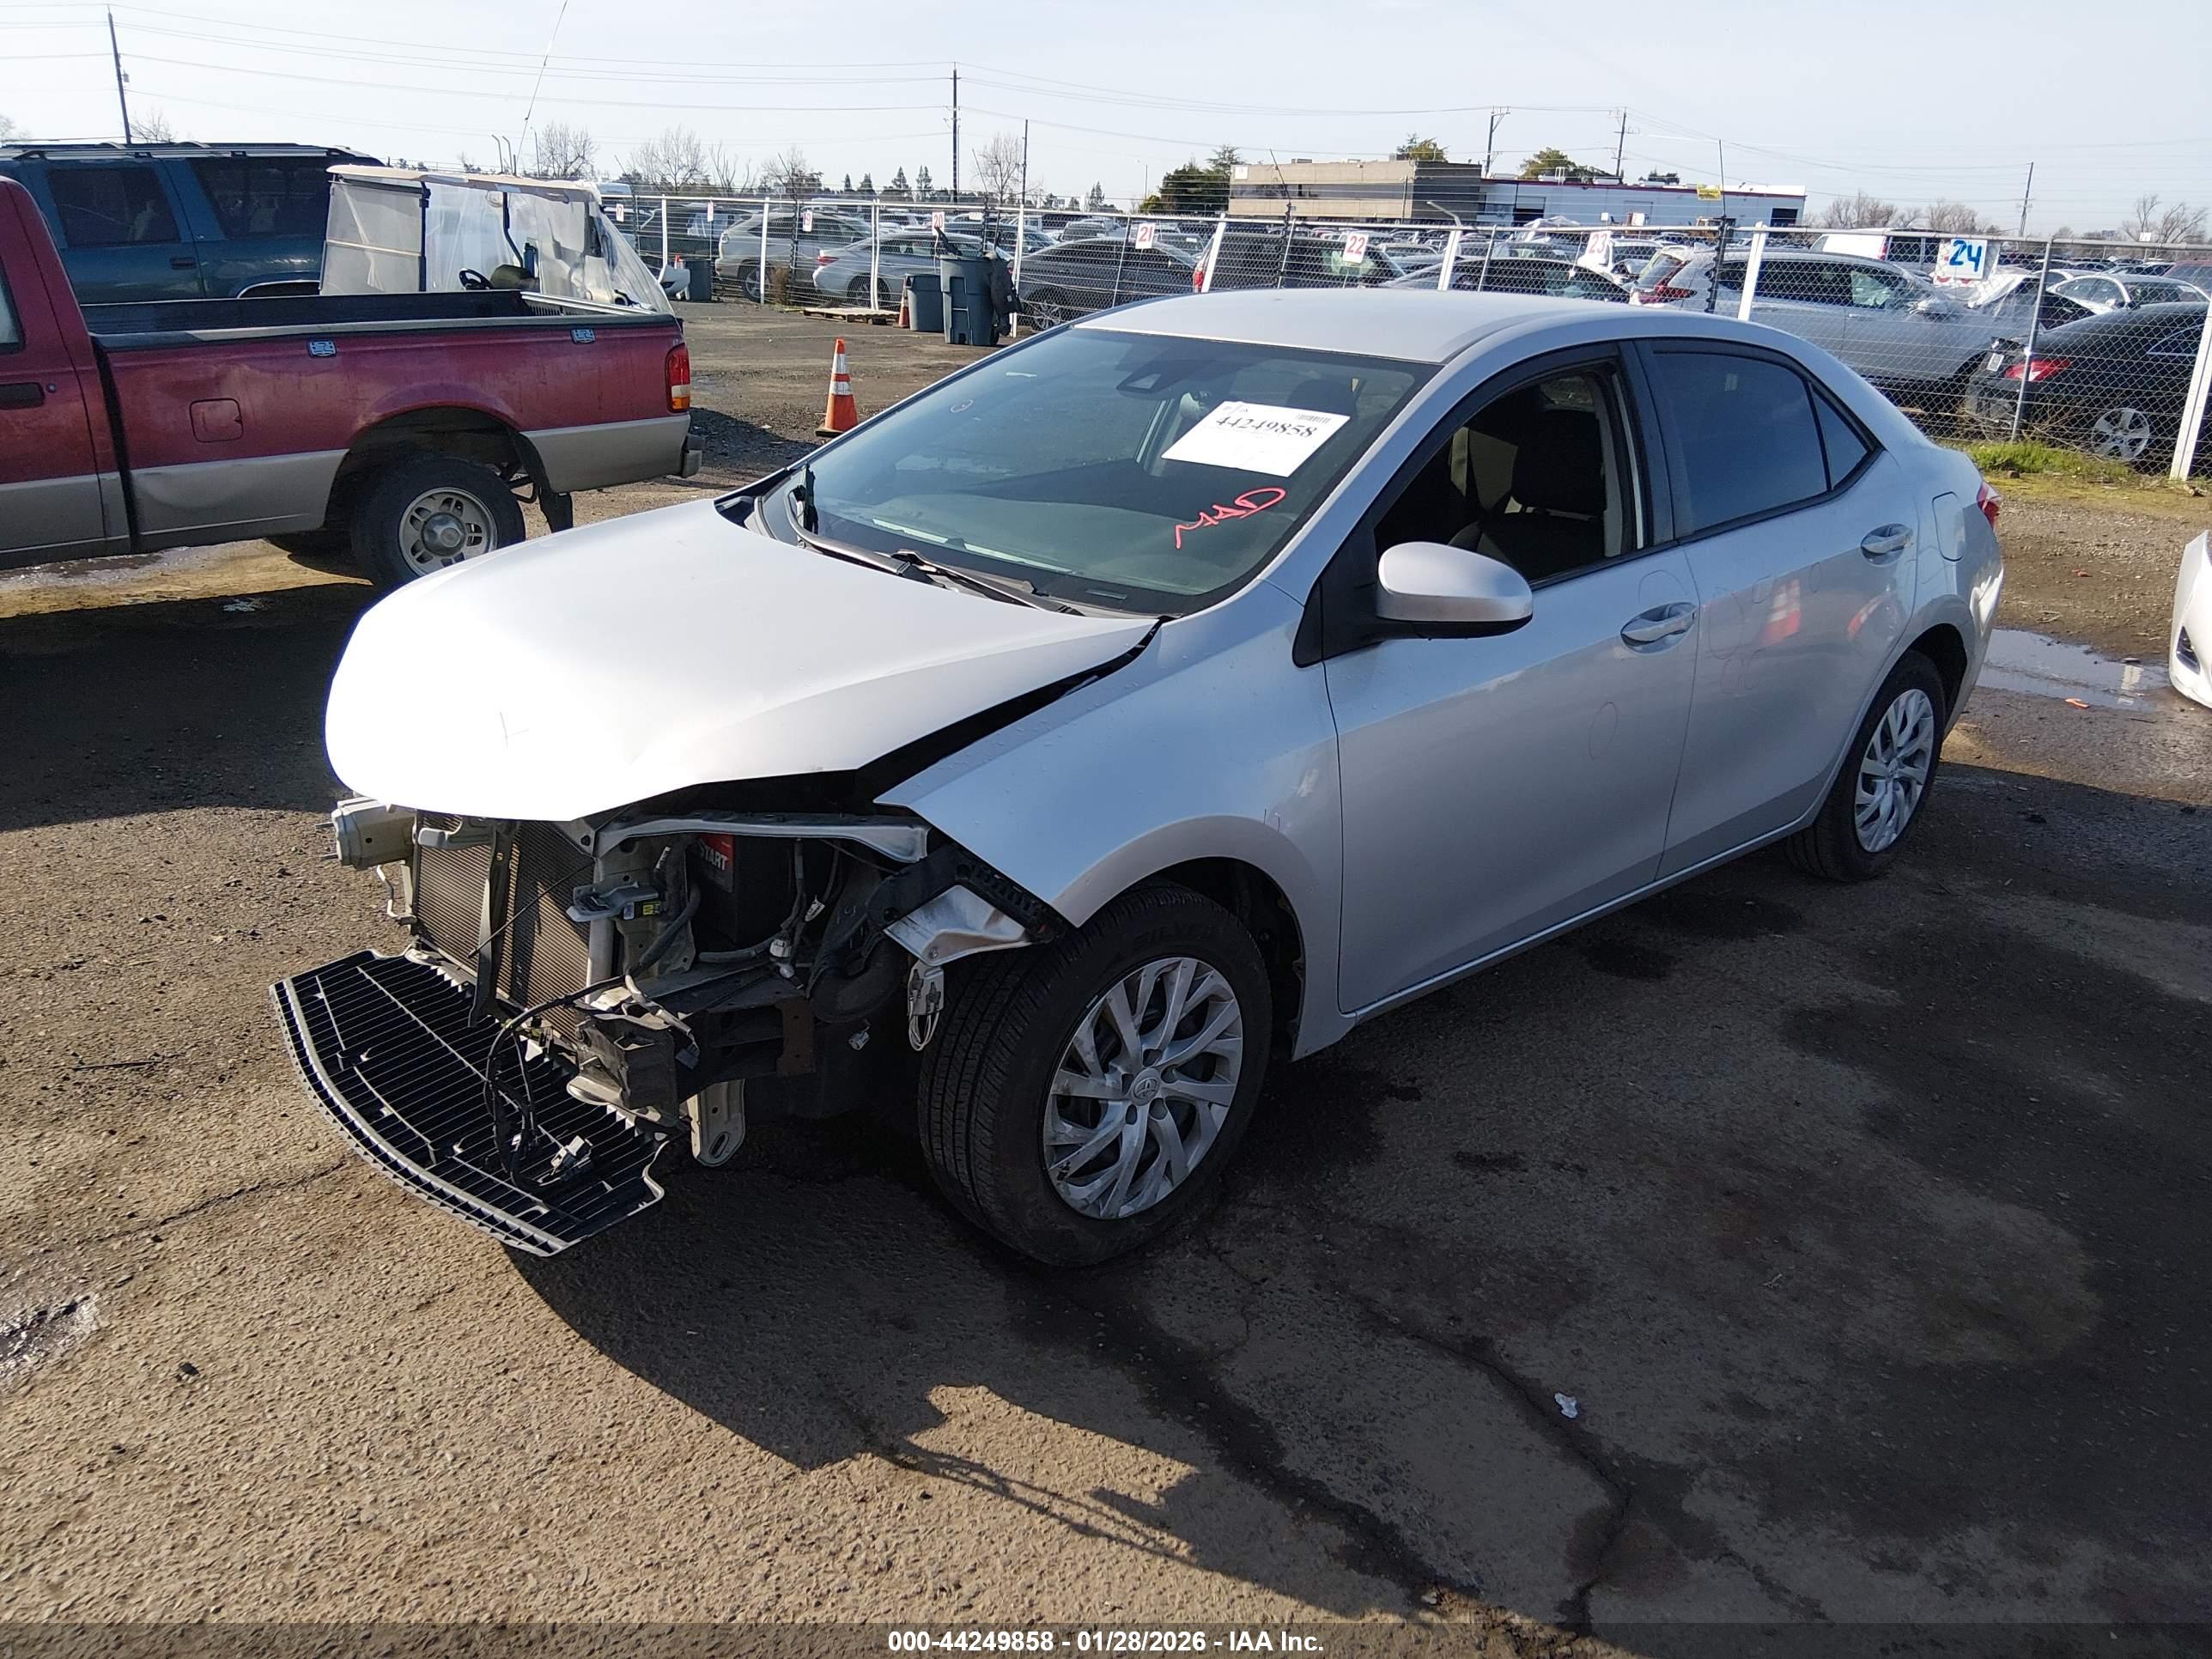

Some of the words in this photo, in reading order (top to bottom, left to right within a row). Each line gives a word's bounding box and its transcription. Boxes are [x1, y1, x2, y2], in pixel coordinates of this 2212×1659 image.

[933, 213, 944, 228] 20
[1138, 226, 1153, 242] 21
[1588, 233, 1608, 254] 23
[1346, 235, 1366, 255] 22
[1948, 239, 1983, 273] 24
[1215, 415, 1318, 439] 44249858
